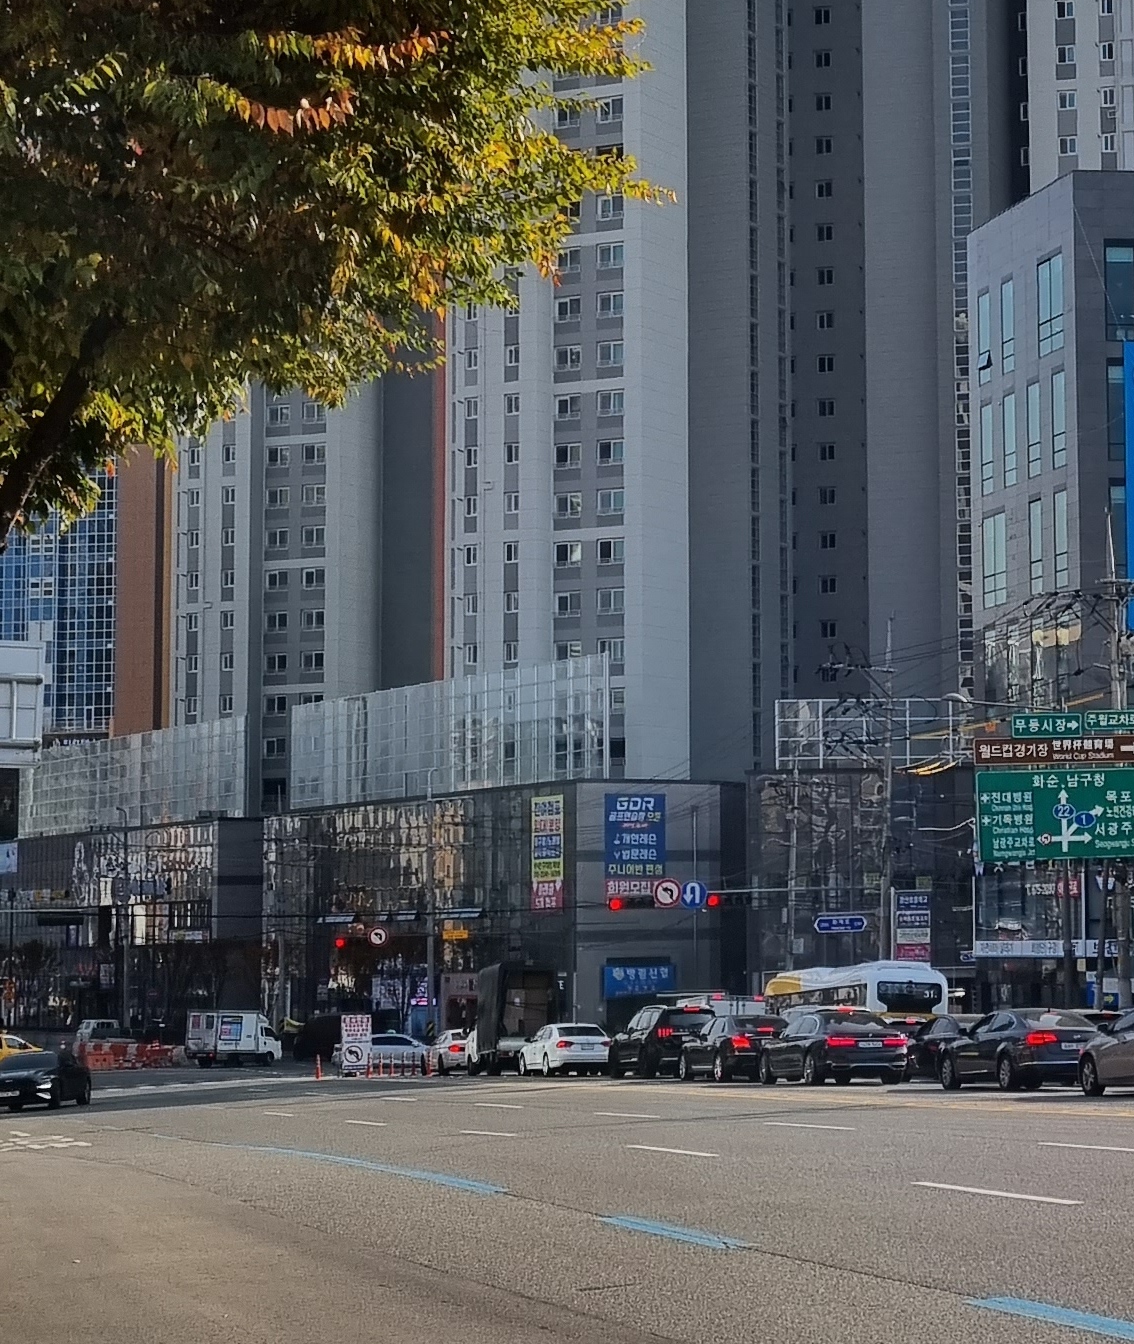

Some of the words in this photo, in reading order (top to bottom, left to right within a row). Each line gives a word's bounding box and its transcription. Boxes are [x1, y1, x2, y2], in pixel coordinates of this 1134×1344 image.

[1014, 718, 1067, 733] 무등시장
[978, 743, 1048, 759] 월드컵경기장
[1067, 773, 1105, 787] 남구청
[1105, 790, 1132, 803] 목포
[616, 797, 655, 811] GDR
[1057, 806, 1070, 817] 22
[622, 833, 657, 845] 개인레슨
[607, 880, 650, 895] 회원모집
